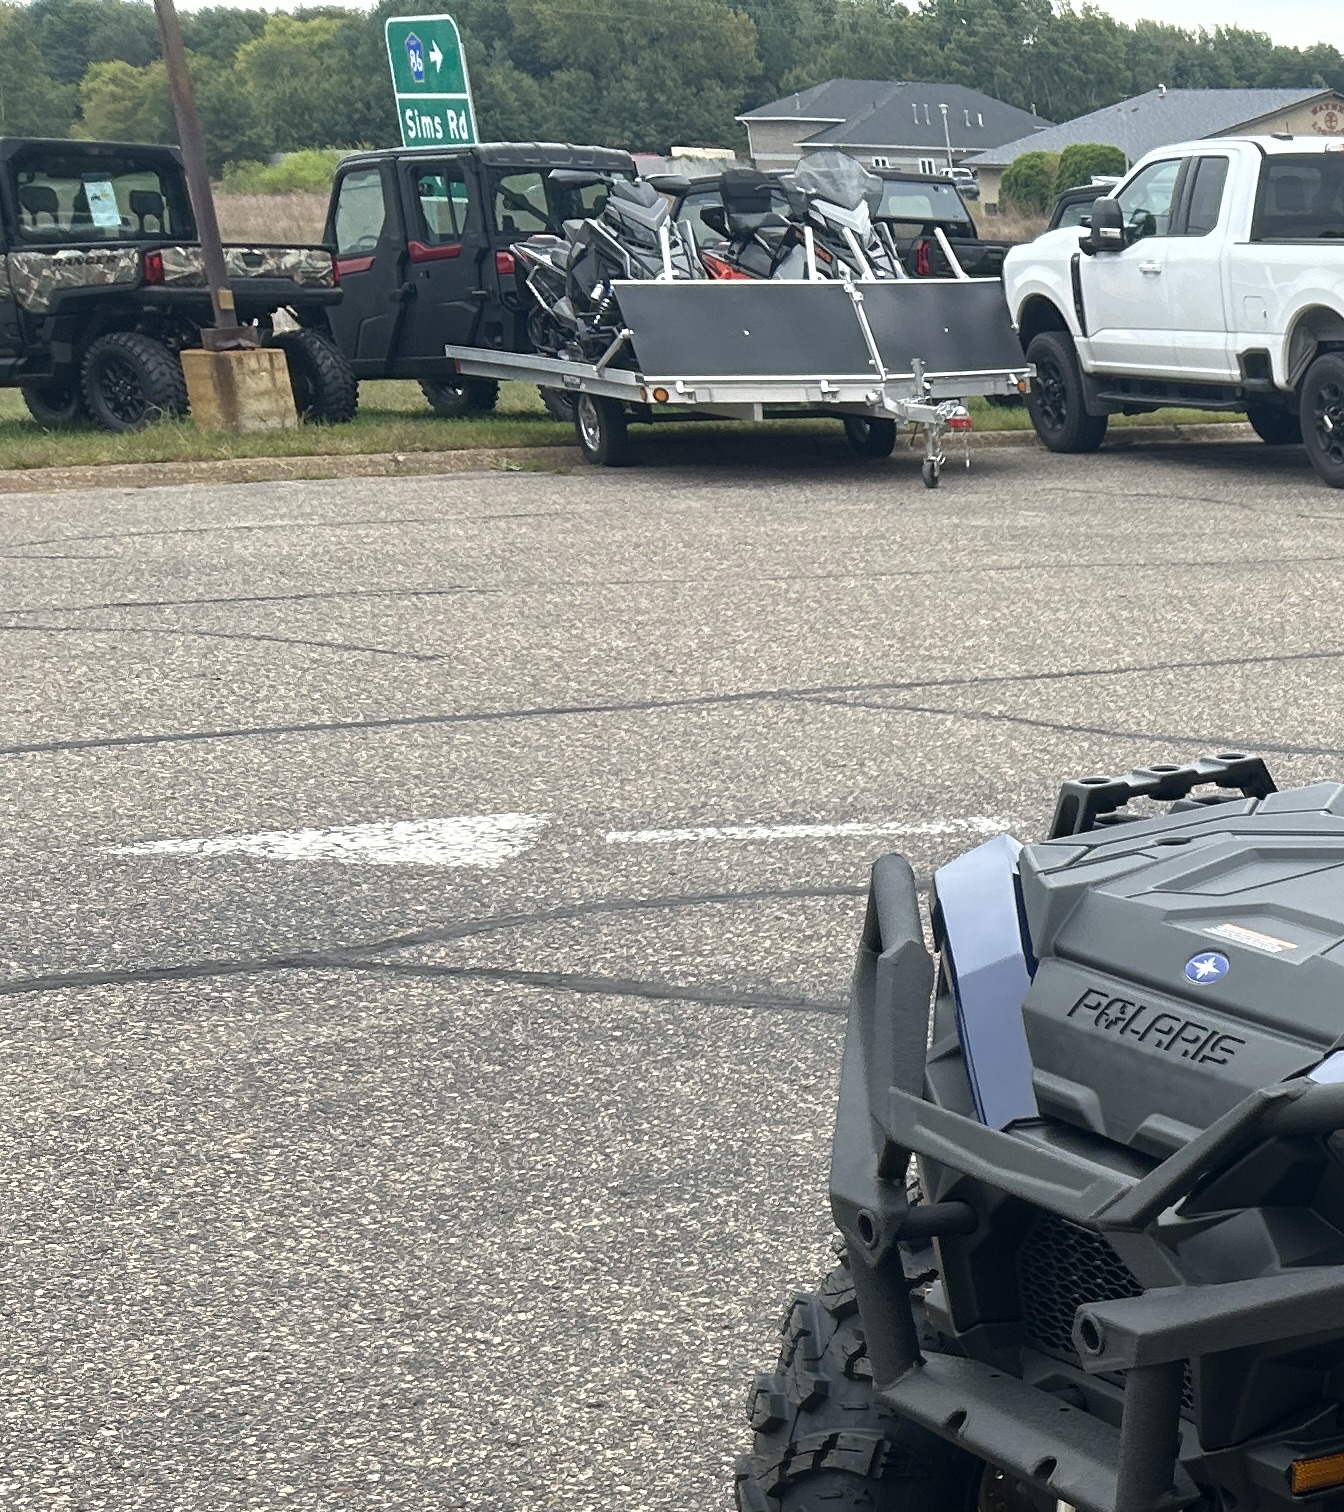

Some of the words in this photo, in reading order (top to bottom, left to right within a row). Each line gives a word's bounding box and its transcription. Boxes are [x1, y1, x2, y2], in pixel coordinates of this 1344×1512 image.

[409, 48, 424, 73] 86
[405, 108, 443, 140] Sims
[446, 108, 469, 140] Rd
[1066, 987, 1247, 1066] POLARIS
